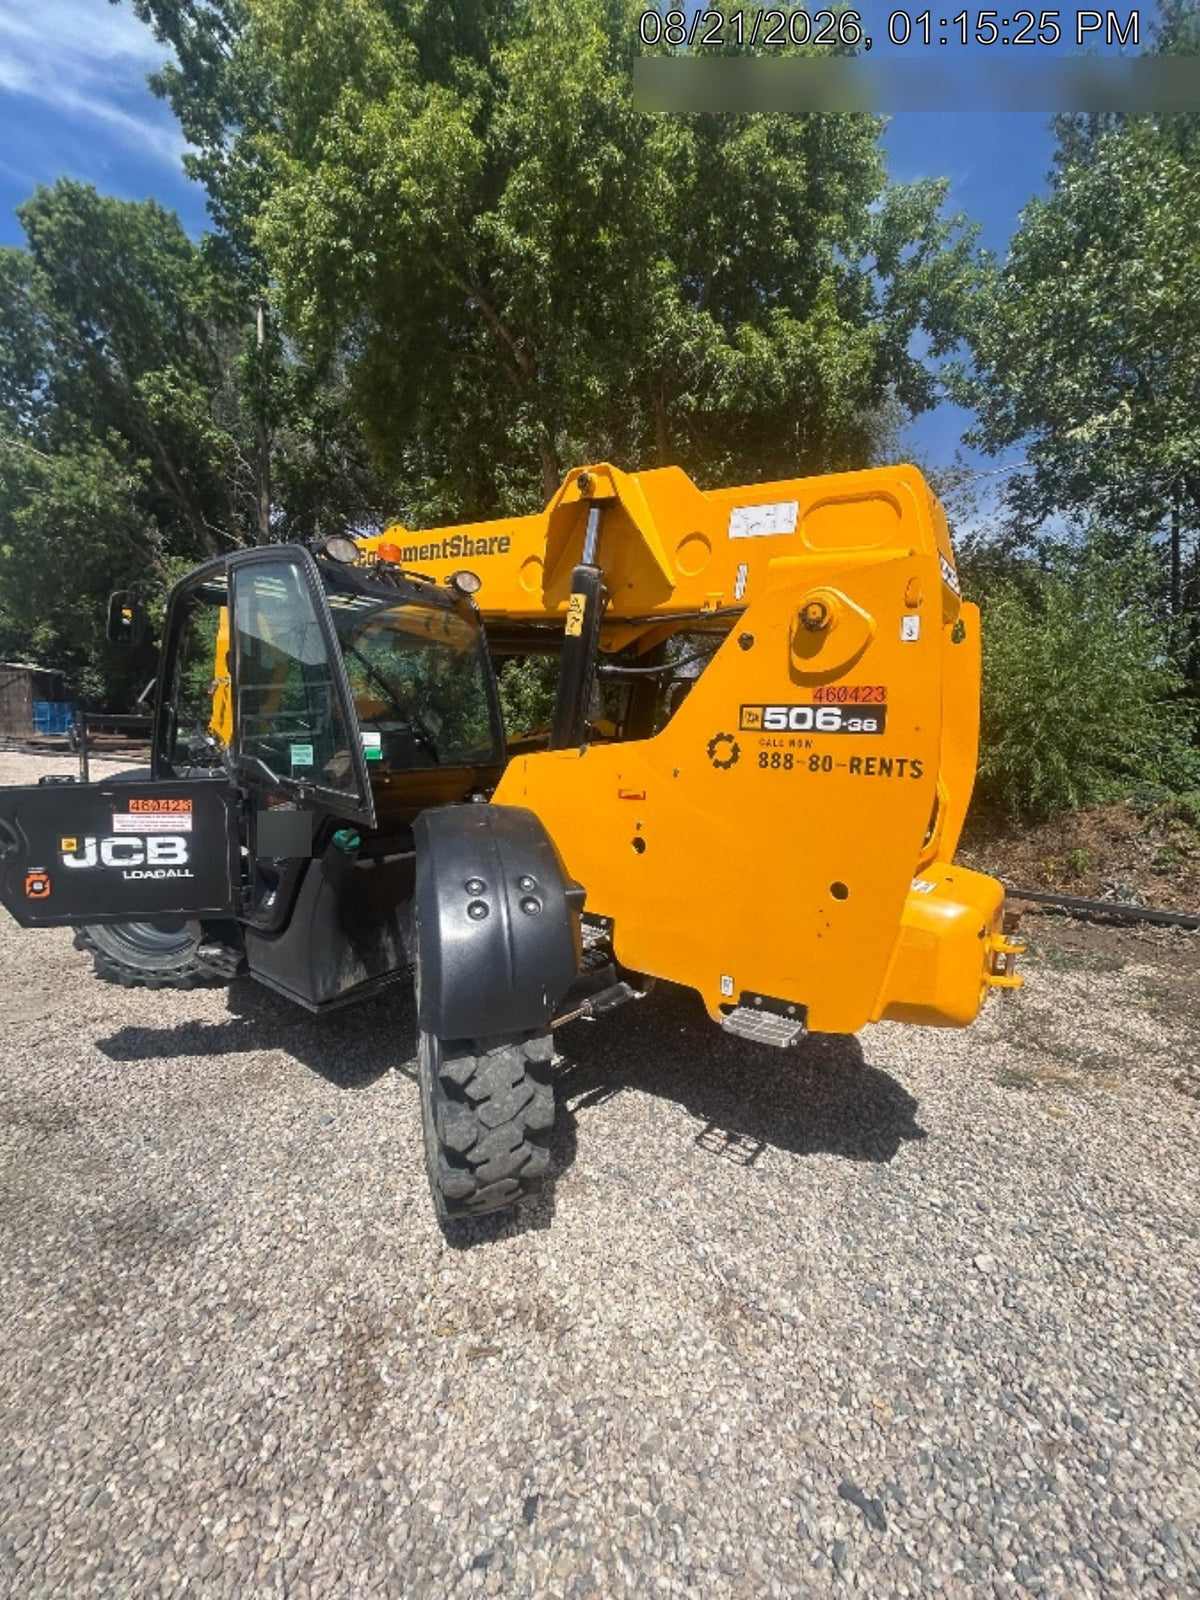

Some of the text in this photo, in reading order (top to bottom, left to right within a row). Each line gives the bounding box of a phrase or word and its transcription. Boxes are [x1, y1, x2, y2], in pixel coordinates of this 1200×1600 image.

[357, 535, 511, 565] EqmentShare
[813, 686, 886, 703] 460423
[758, 737, 785, 748] CALL
[758, 751, 924, 779] 888-80-RENTS
[62, 836, 189, 868] JCB
[122, 868, 195, 879] LOADALL
